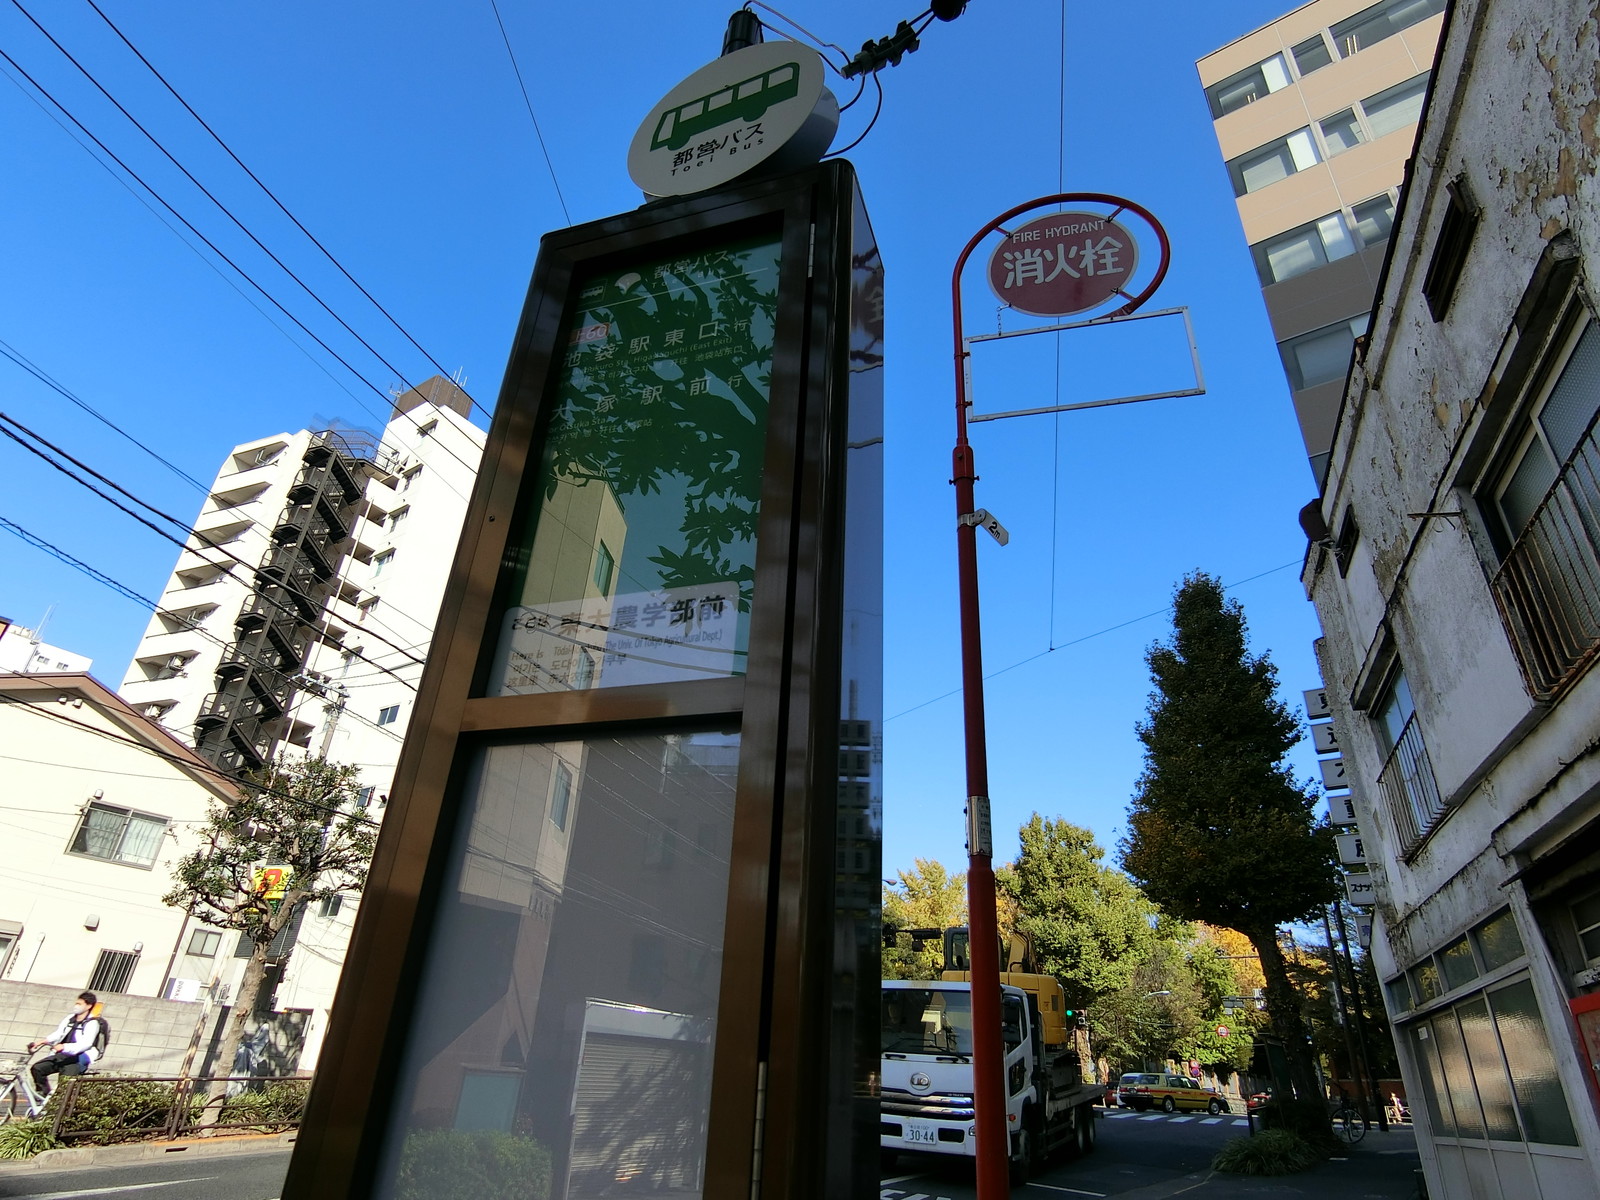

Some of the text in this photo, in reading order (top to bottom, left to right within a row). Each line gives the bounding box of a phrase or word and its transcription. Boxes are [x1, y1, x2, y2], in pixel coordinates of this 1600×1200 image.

[671, 137, 765, 177] Toei Bus
[672, 122, 764, 168] 都営バス
[1012, 219, 1106, 244] FIRE HYDRANT
[653, 250, 729, 280] 都営バス
[1002, 235, 1124, 289] 消火栓
